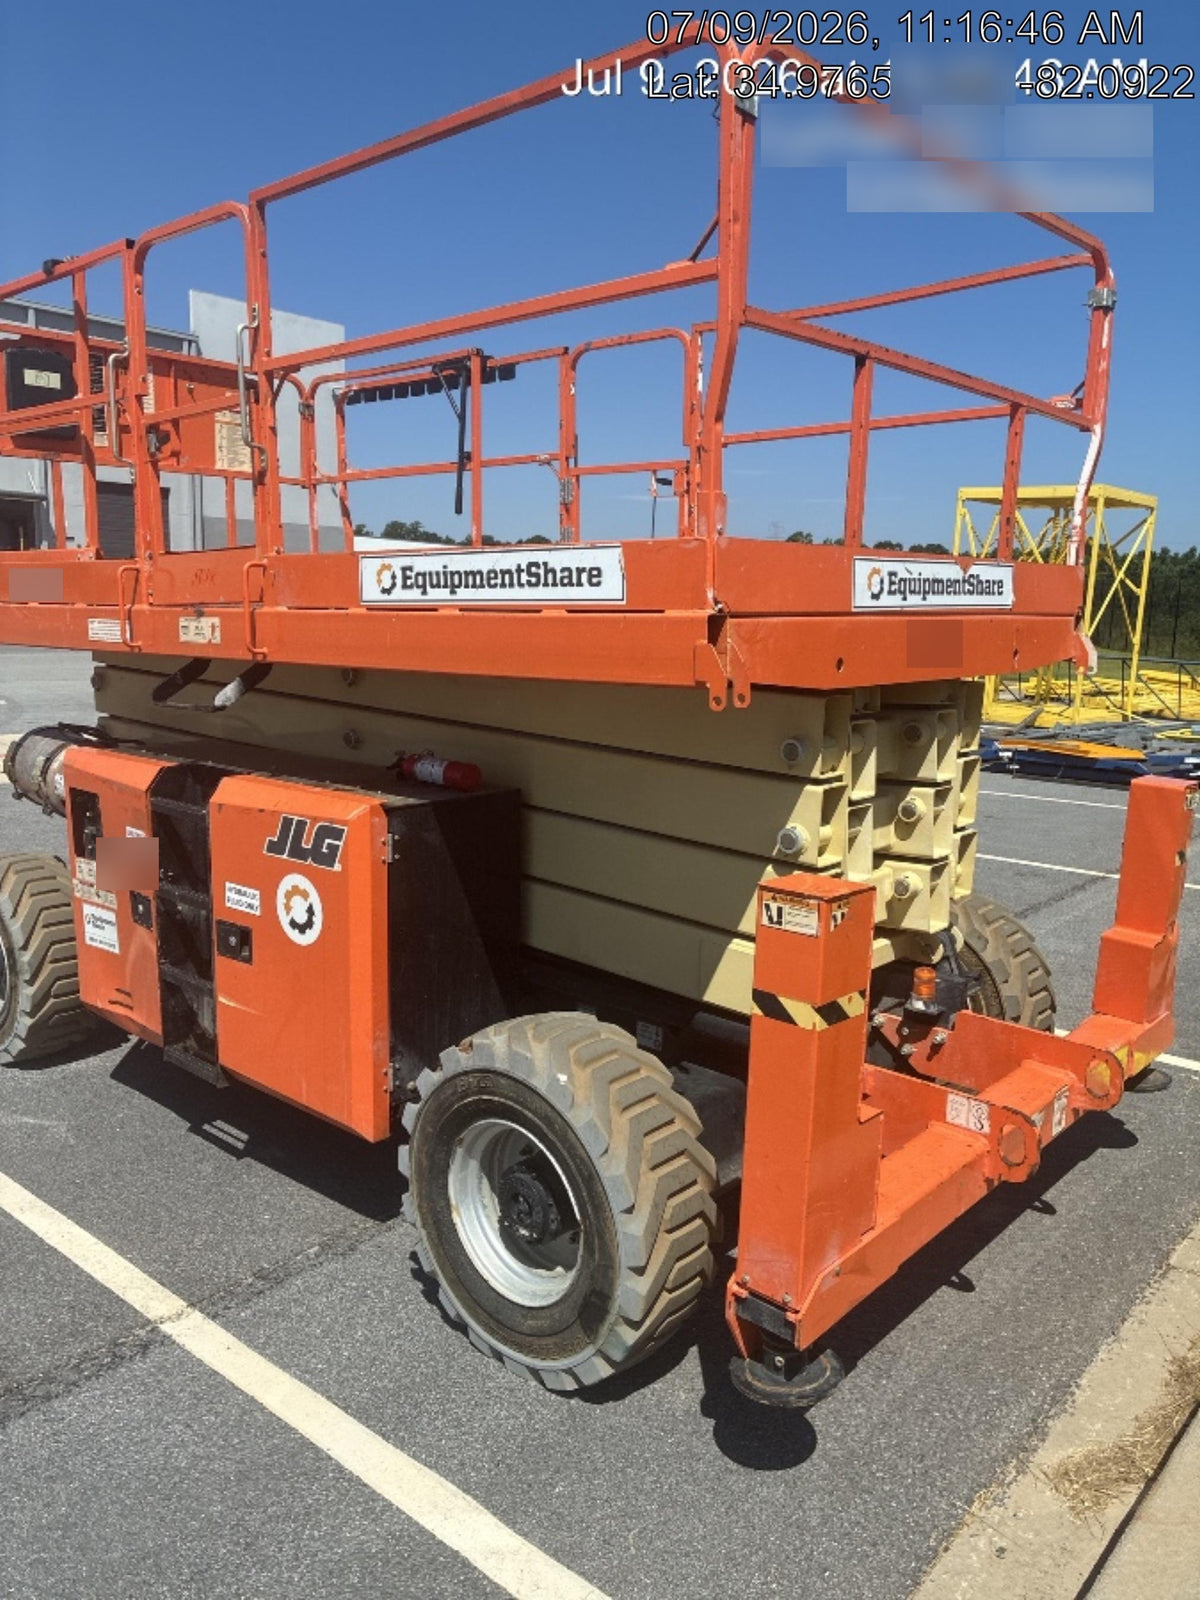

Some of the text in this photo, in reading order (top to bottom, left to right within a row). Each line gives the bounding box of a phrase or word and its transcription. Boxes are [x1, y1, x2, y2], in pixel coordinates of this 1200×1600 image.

[400, 561, 603, 596] EquipmentShare
[887, 571, 1004, 601] EquipmentShare
[263, 813, 347, 871] JLG
